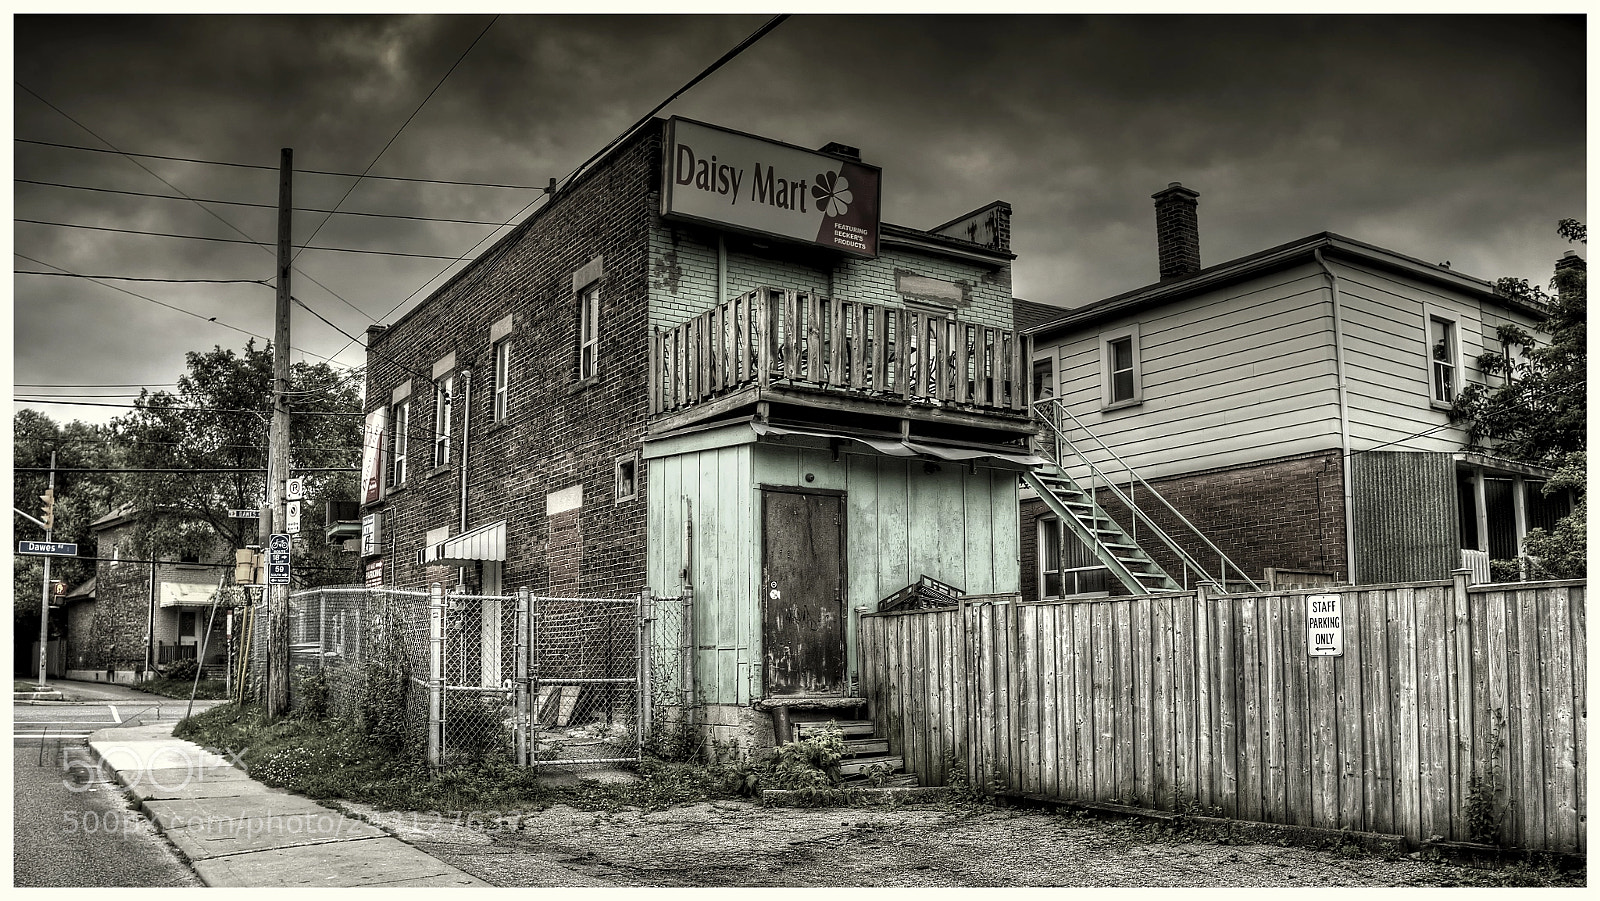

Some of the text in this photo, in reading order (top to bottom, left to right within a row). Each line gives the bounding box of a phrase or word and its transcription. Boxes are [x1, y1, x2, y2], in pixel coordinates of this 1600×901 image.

[676, 143, 807, 213] Daisy Mart
[834, 222, 868, 235] FEATURING
[834, 230, 864, 242] BECKER'S
[834, 237, 866, 250] PRODUCTS
[28, 542, 56, 552] Dawes
[274, 565, 285, 573] 59
[1312, 600, 1336, 613] STAFF
[1309, 616, 1340, 629] PARKING
[1315, 632, 1335, 645] ONLY
